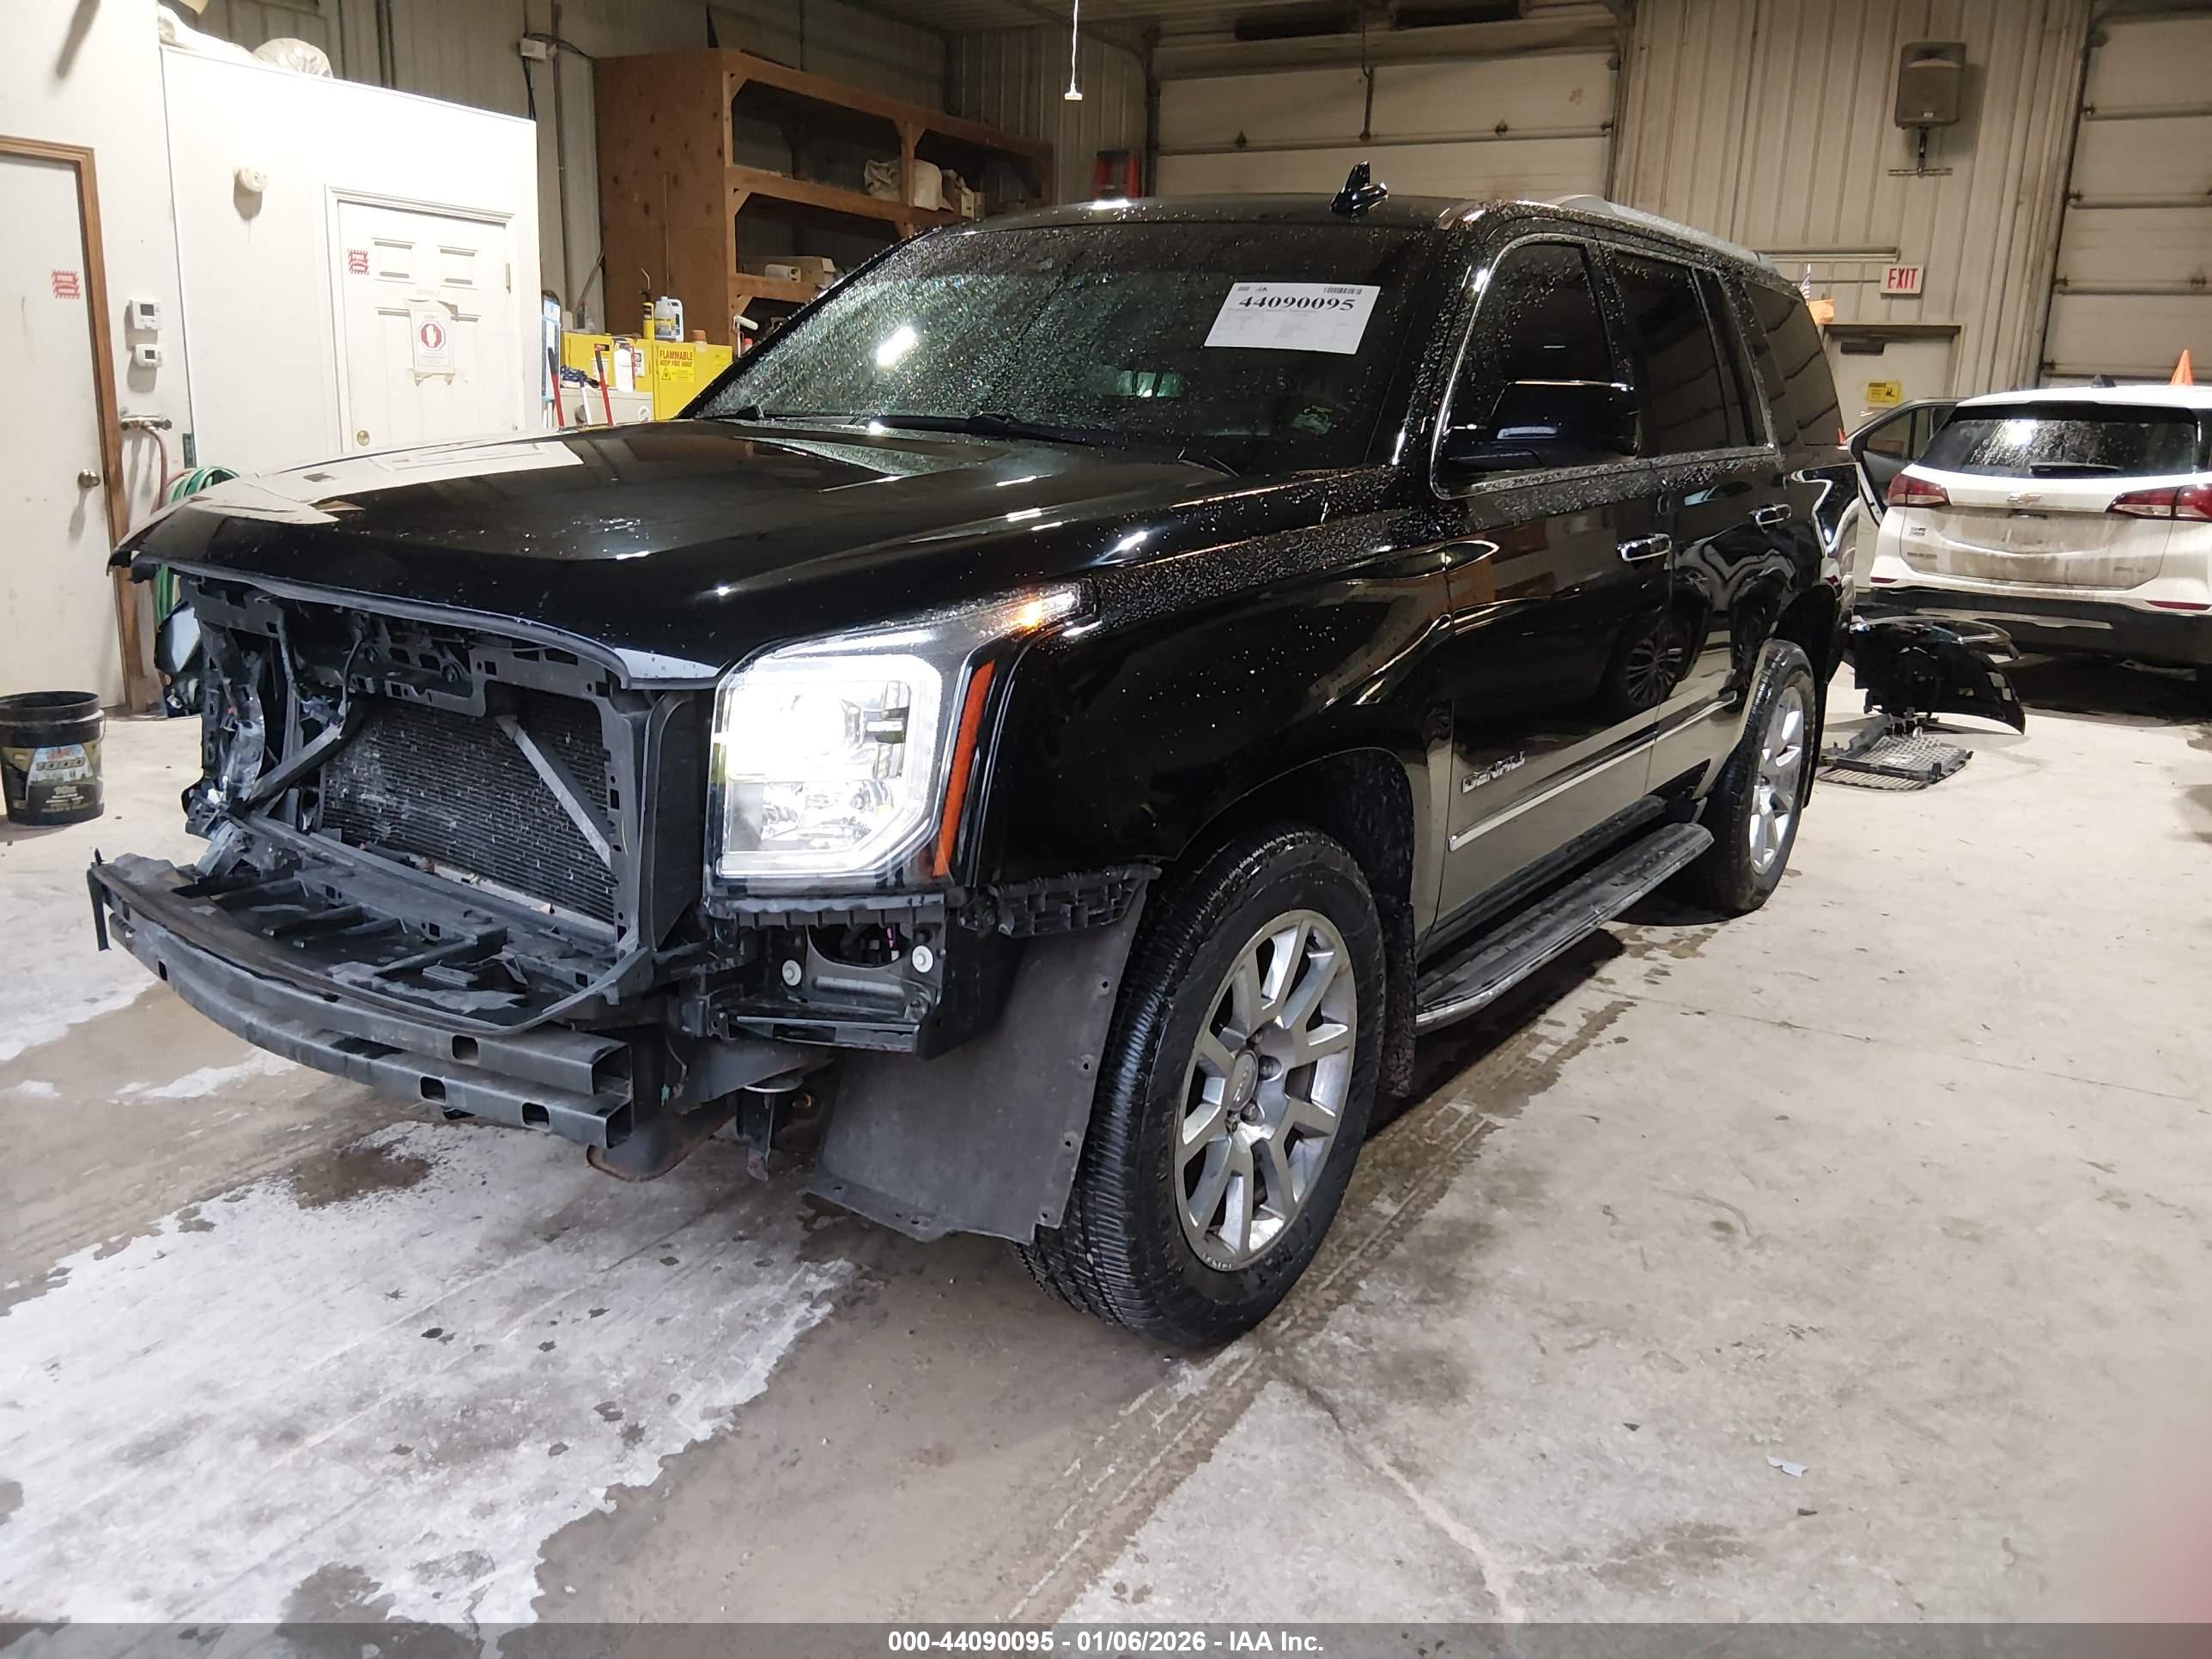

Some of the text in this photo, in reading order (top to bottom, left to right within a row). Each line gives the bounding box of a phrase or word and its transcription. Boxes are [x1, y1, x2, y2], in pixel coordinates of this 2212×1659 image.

[1887, 268, 1918, 289] EXIT
[1239, 295, 1356, 311] 44090095
[659, 350, 694, 361] FLAMMABLE
